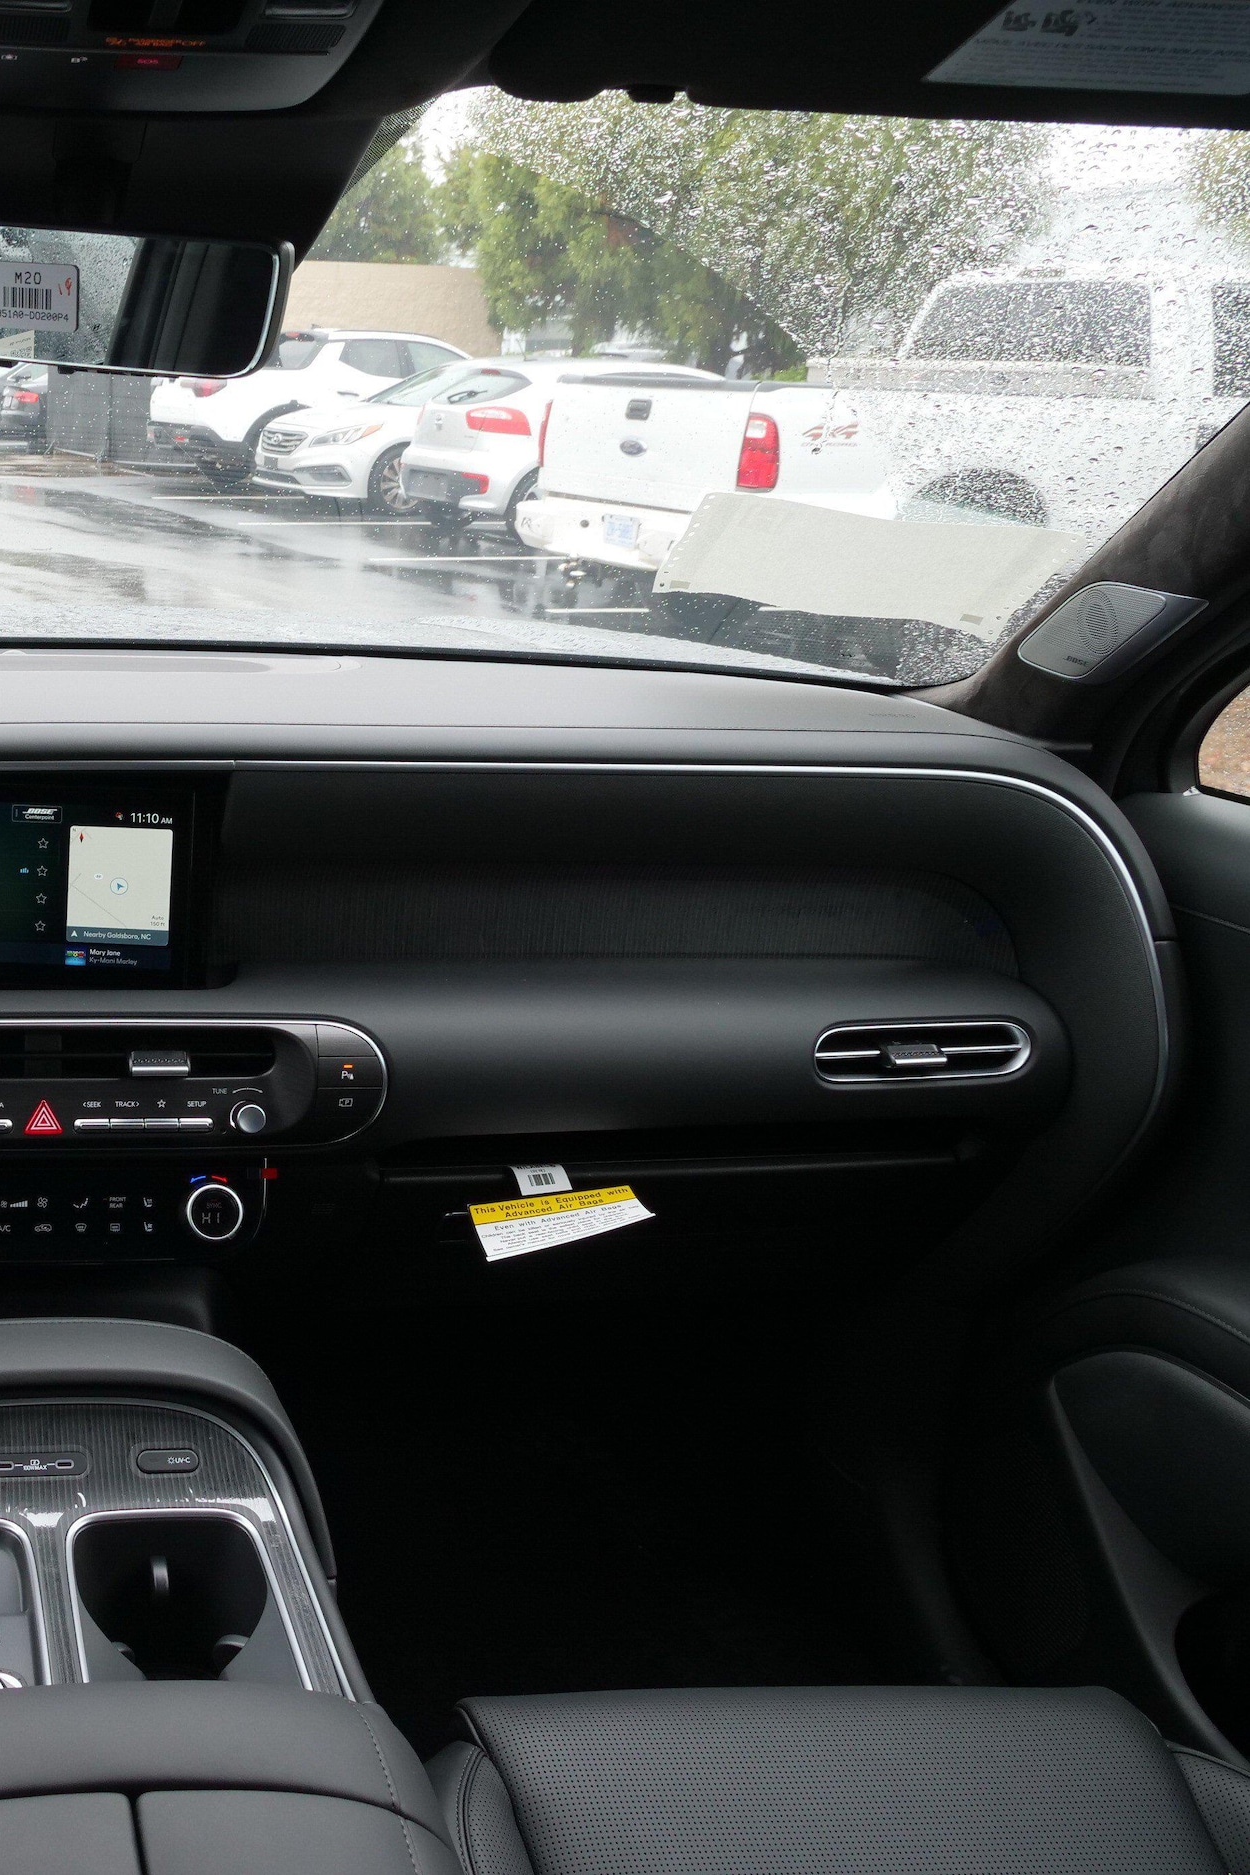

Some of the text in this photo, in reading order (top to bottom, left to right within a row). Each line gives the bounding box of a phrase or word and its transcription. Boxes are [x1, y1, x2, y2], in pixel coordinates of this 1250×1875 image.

[130, 812, 173, 825] 11:10 AM
[83, 930, 107, 939] Nearby
[106, 931, 140, 940] Goldsboro,
[89, 948, 107, 957] Mary
[106, 949, 121, 957] Jane
[473, 1206, 496, 1215] This
[498, 1201, 535, 1212] Vehicle
[555, 1191, 602, 1204] Equipped
[607, 1188, 629, 1196] with
[505, 1206, 553, 1218] Advanced
[579, 1198, 604, 1207] Bags
[541, 1212, 580, 1223] Advanced
[601, 1204, 622, 1212] Bags
